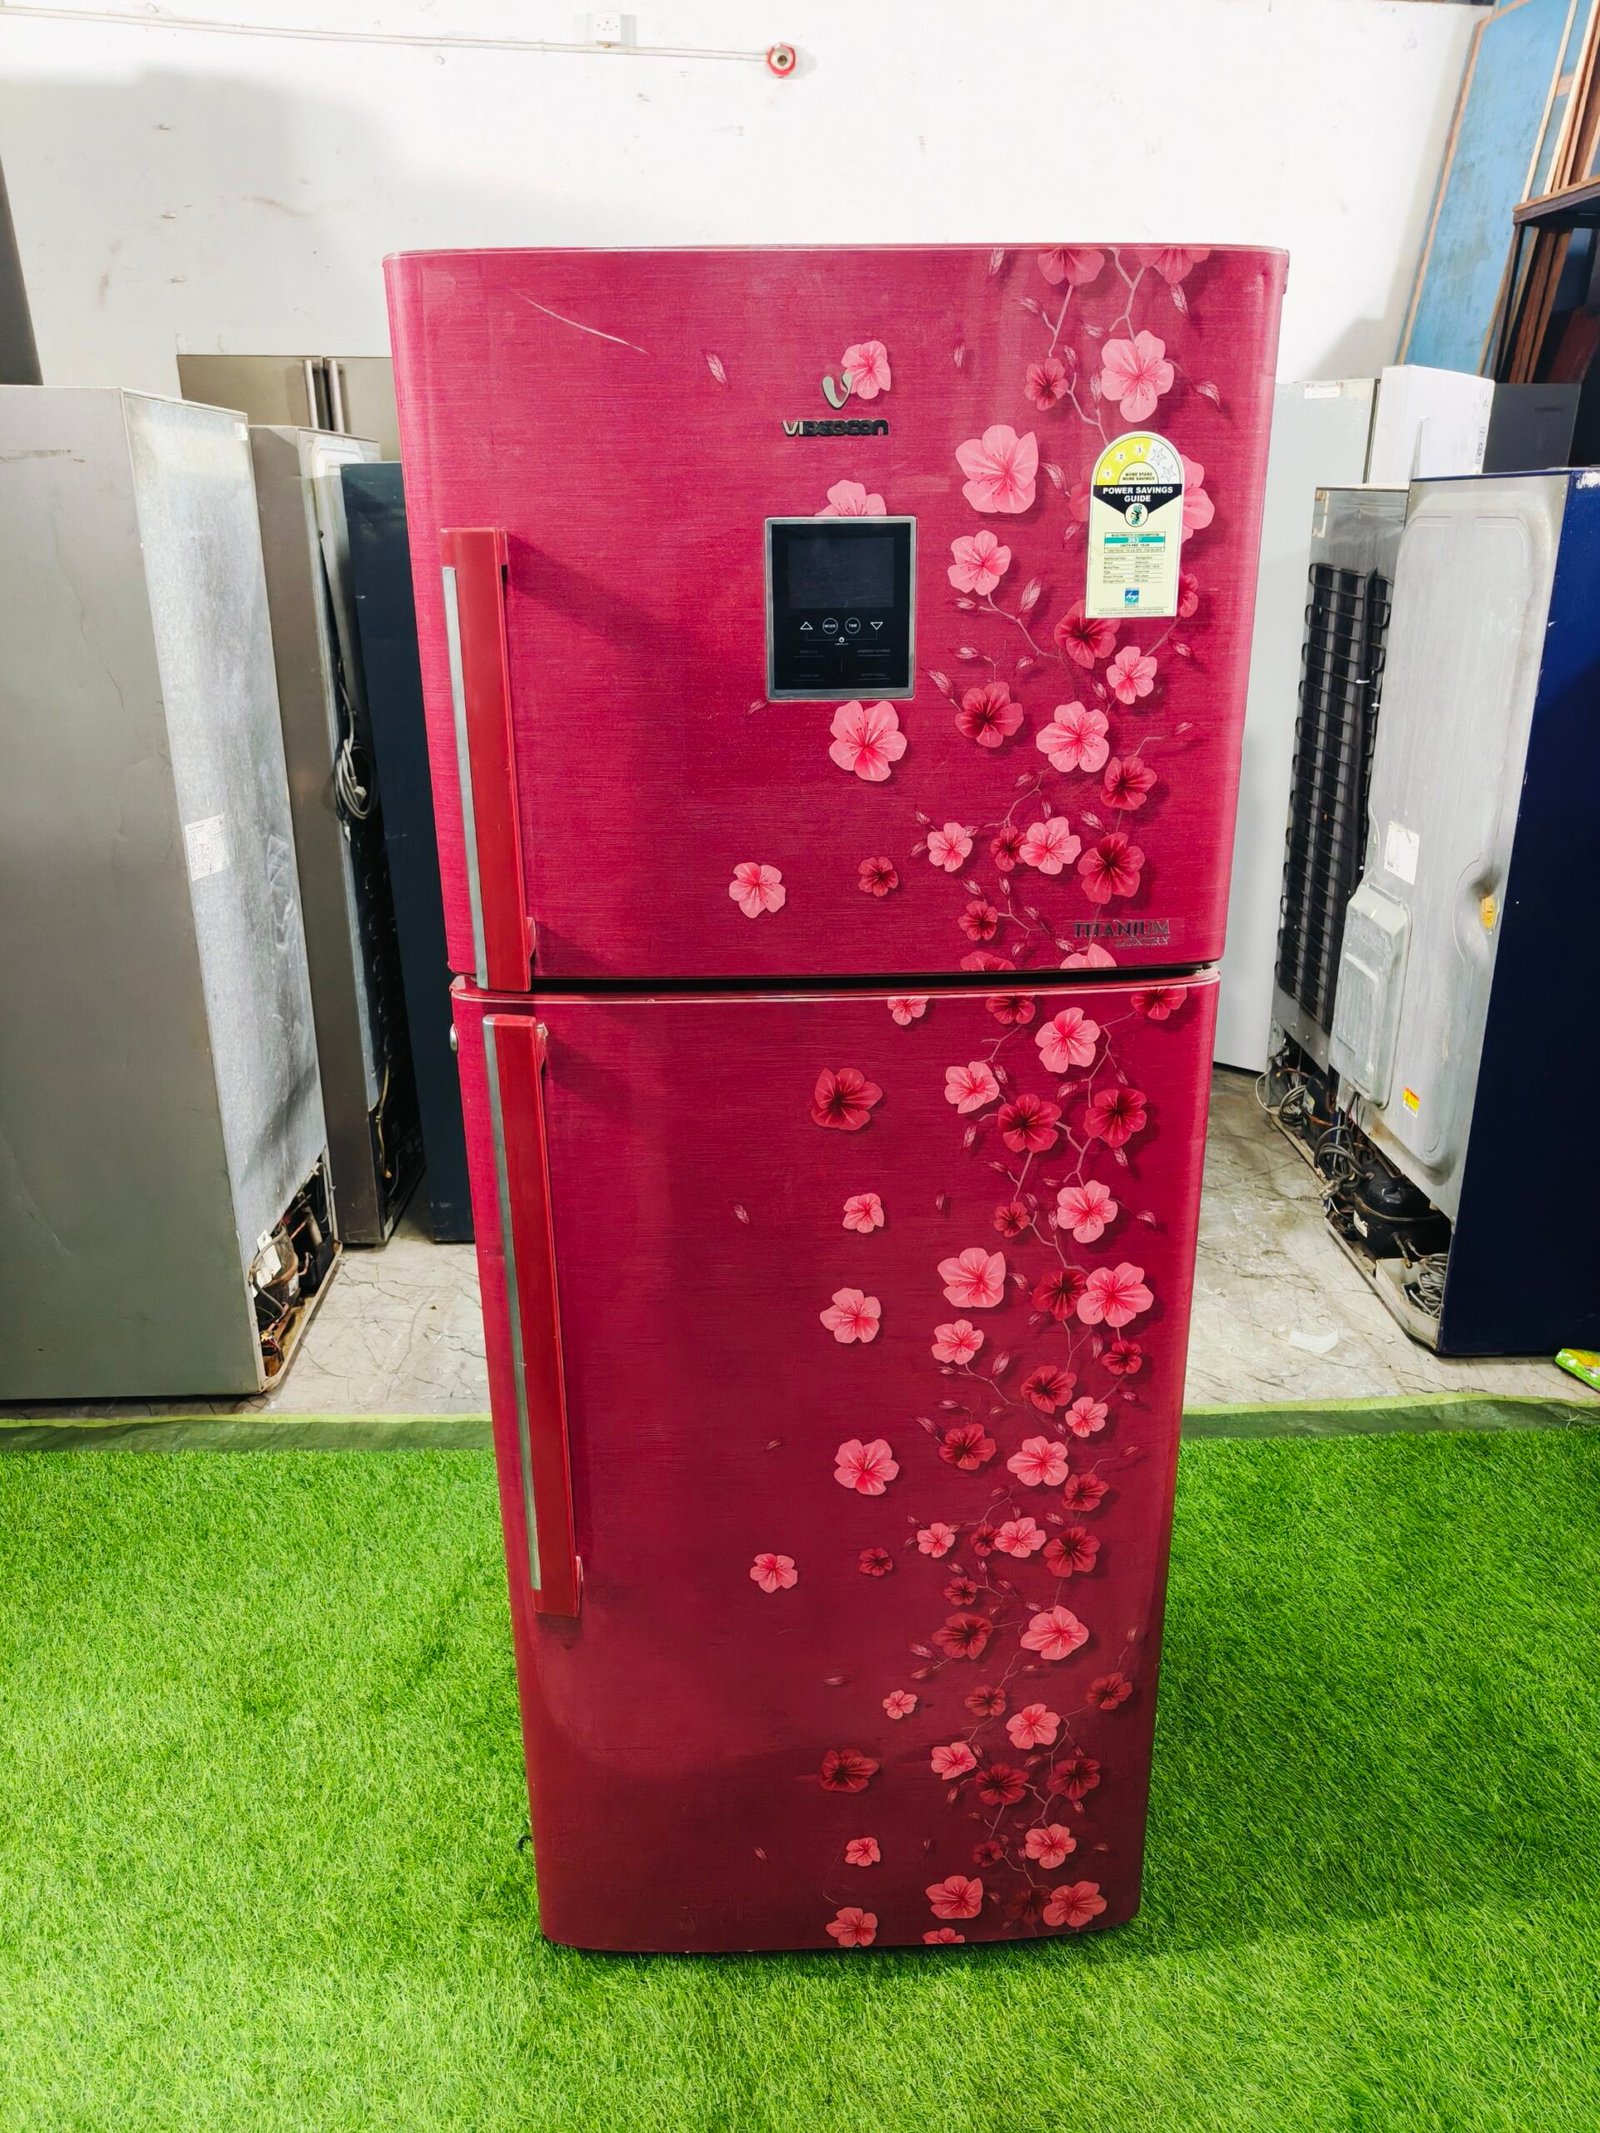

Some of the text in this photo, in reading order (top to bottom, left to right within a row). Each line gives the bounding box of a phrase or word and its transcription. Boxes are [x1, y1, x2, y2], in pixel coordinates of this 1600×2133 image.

[1102, 486, 1173, 495] POWER SAVINGS
[1073, 919, 1171, 938] TITANIUM
